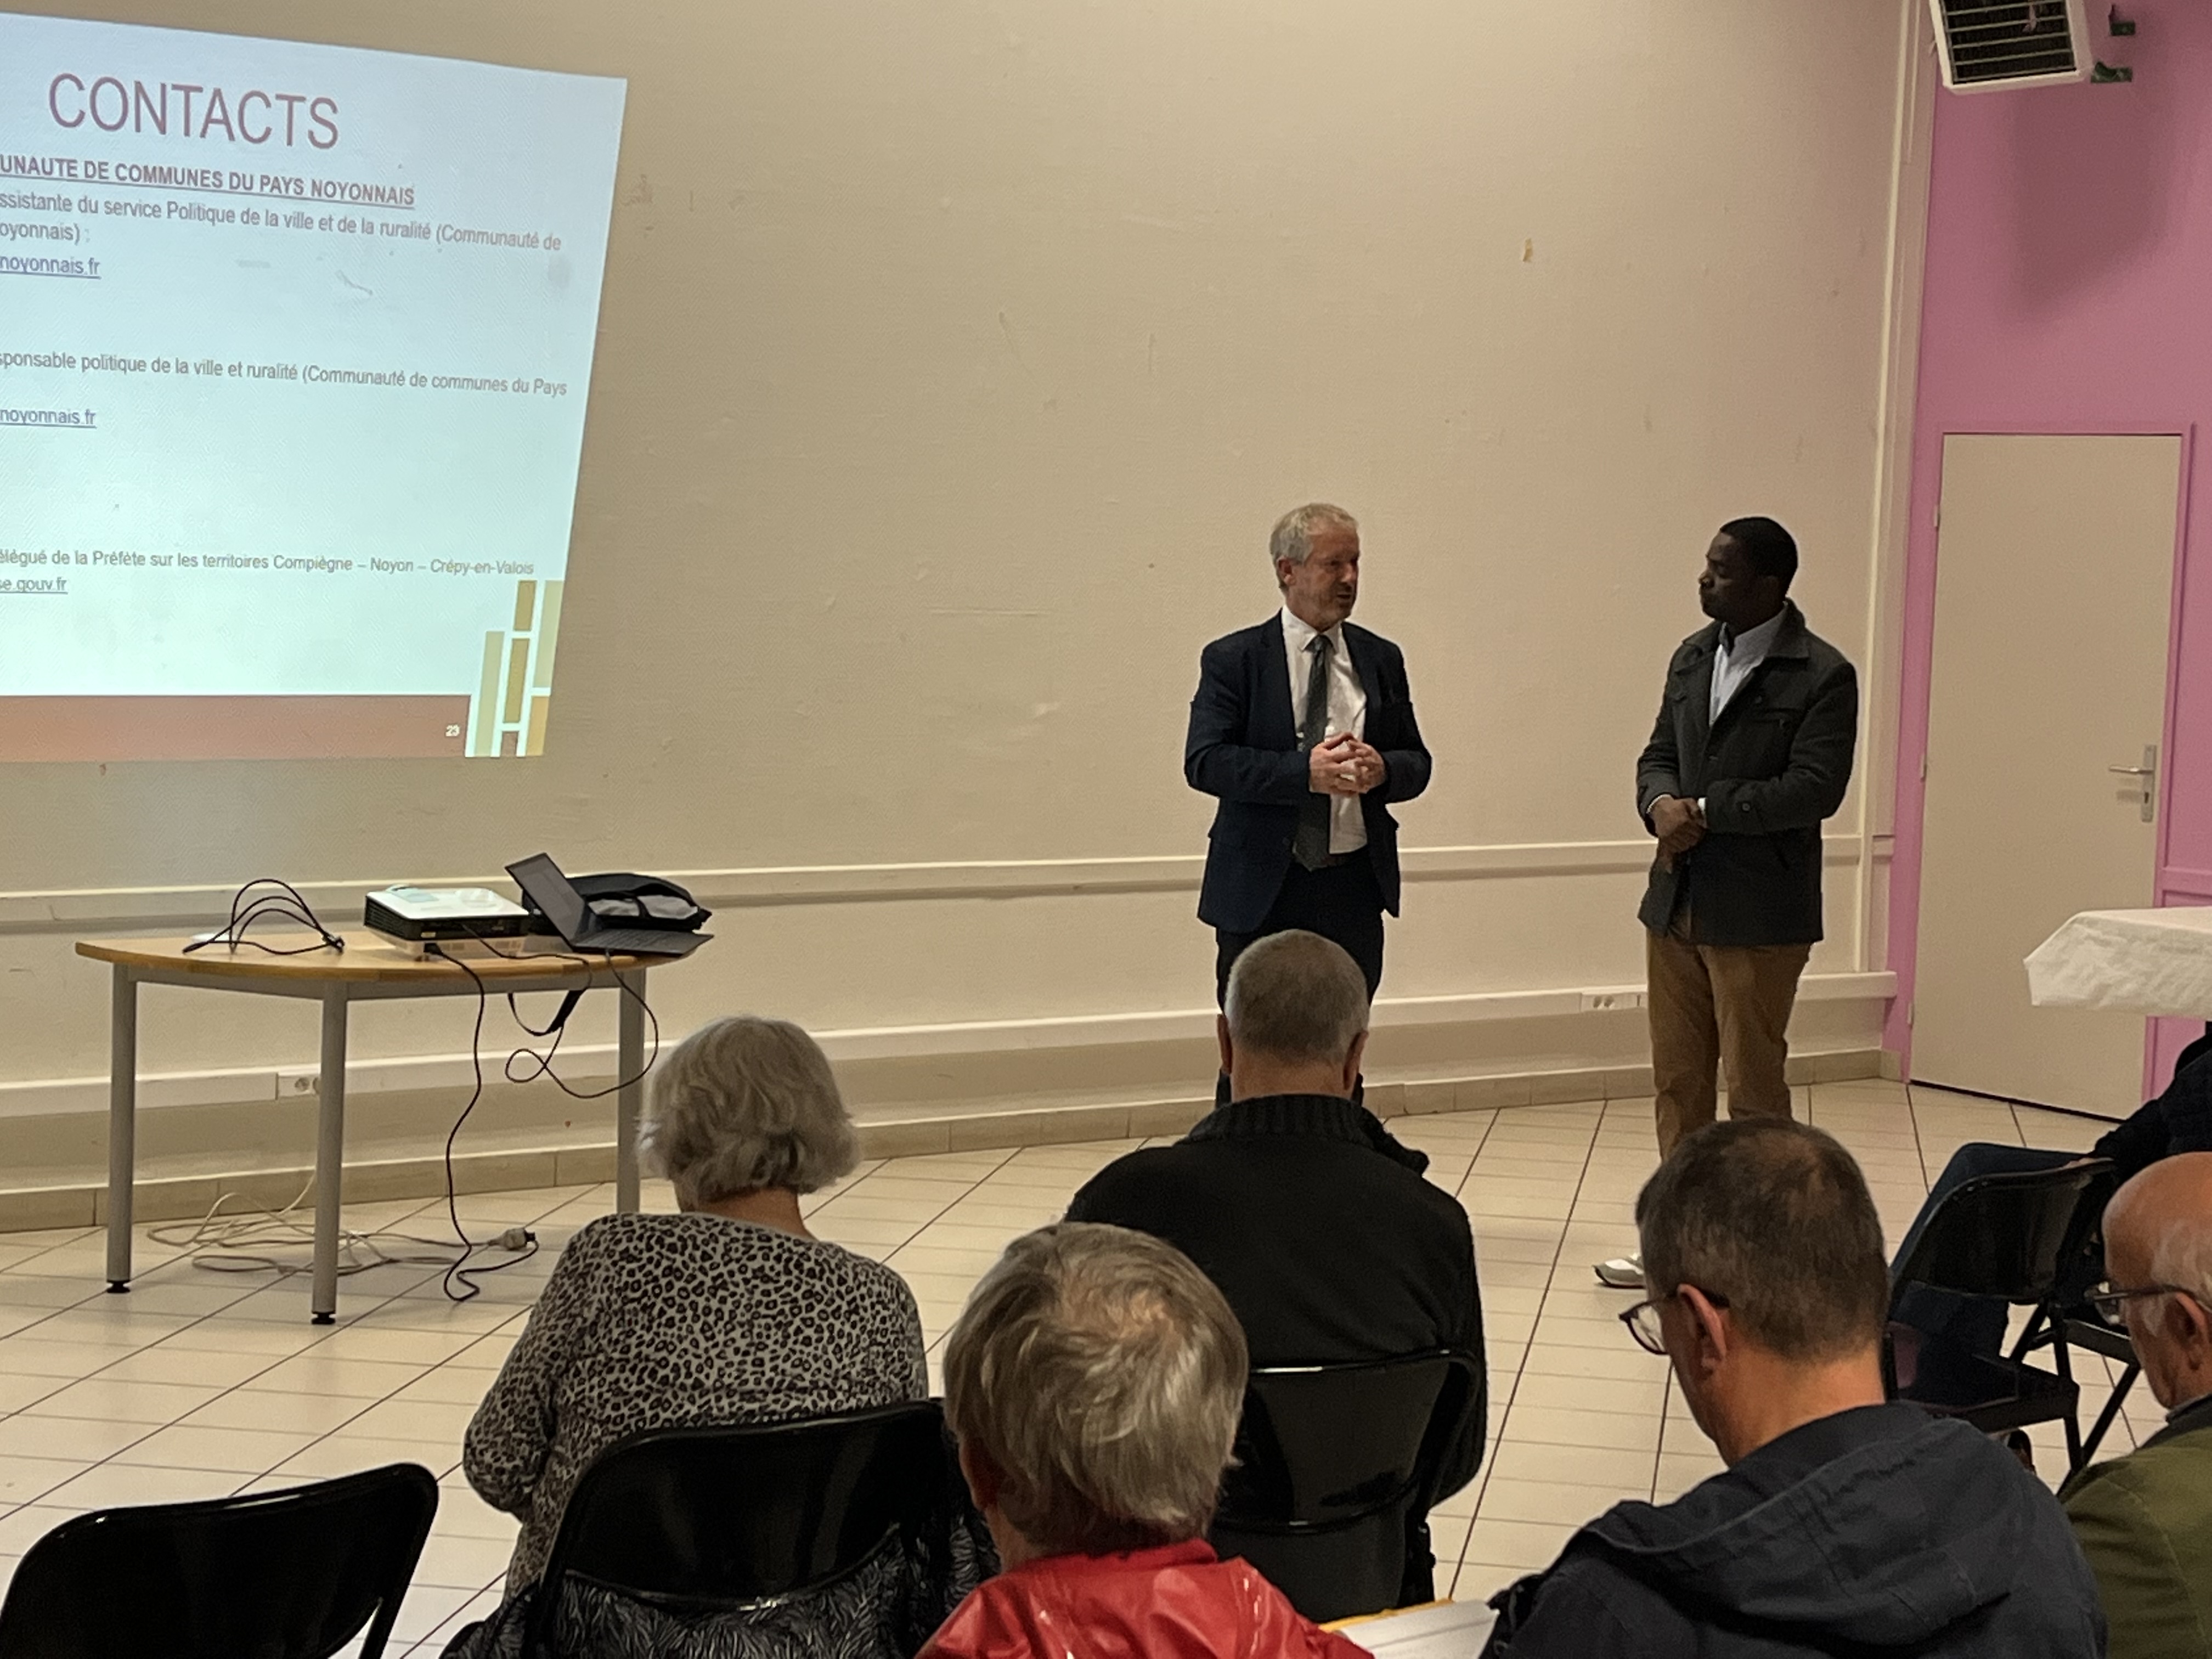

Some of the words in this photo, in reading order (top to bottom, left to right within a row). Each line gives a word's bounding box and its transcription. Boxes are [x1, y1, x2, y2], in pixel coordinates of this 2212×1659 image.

[49, 73, 338, 149] CONTACTS
[0, 154, 78, 178] UNAUTE
[84, 161, 110, 179] DE
[115, 163, 223, 188] COMMUNES
[229, 172, 253, 191] DU
[260, 174, 304, 195] PAYS
[311, 179, 414, 205] NOYONNAIS
[78, 195, 98, 213] du
[104, 199, 162, 218] service
[167, 201, 235, 227] Politique
[241, 207, 260, 225] de
[266, 209, 279, 227] la
[284, 211, 313, 230] ville
[318, 214, 332, 232] et
[338, 216, 357, 233] de
[362, 217, 374, 235] la
[380, 221, 431, 240] ruralité
[436, 223, 539, 249] (Communauté
[543, 233, 561, 251] de
[81, 354, 146, 375] politique
[151, 357, 171, 373] de
[176, 358, 189, 374] la
[194, 359, 223, 376] ville
[228, 362, 242, 377] et
[247, 363, 298, 380] ruralité
[302, 365, 405, 386] (Communauté
[409, 372, 428, 387] de
[431, 375, 508, 392] communes
[512, 378, 529, 393] du
[533, 379, 567, 398] Pays
[52, 550, 70, 565] de
[75, 550, 88, 565] la
[150, 554, 174, 566] sur
[178, 552, 199, 567] les
[203, 554, 269, 568] territoires
[274, 555, 353, 572] Compiègne
[370, 557, 413, 574] Noyon
[431, 558, 534, 575] Crépy-en-Valois
